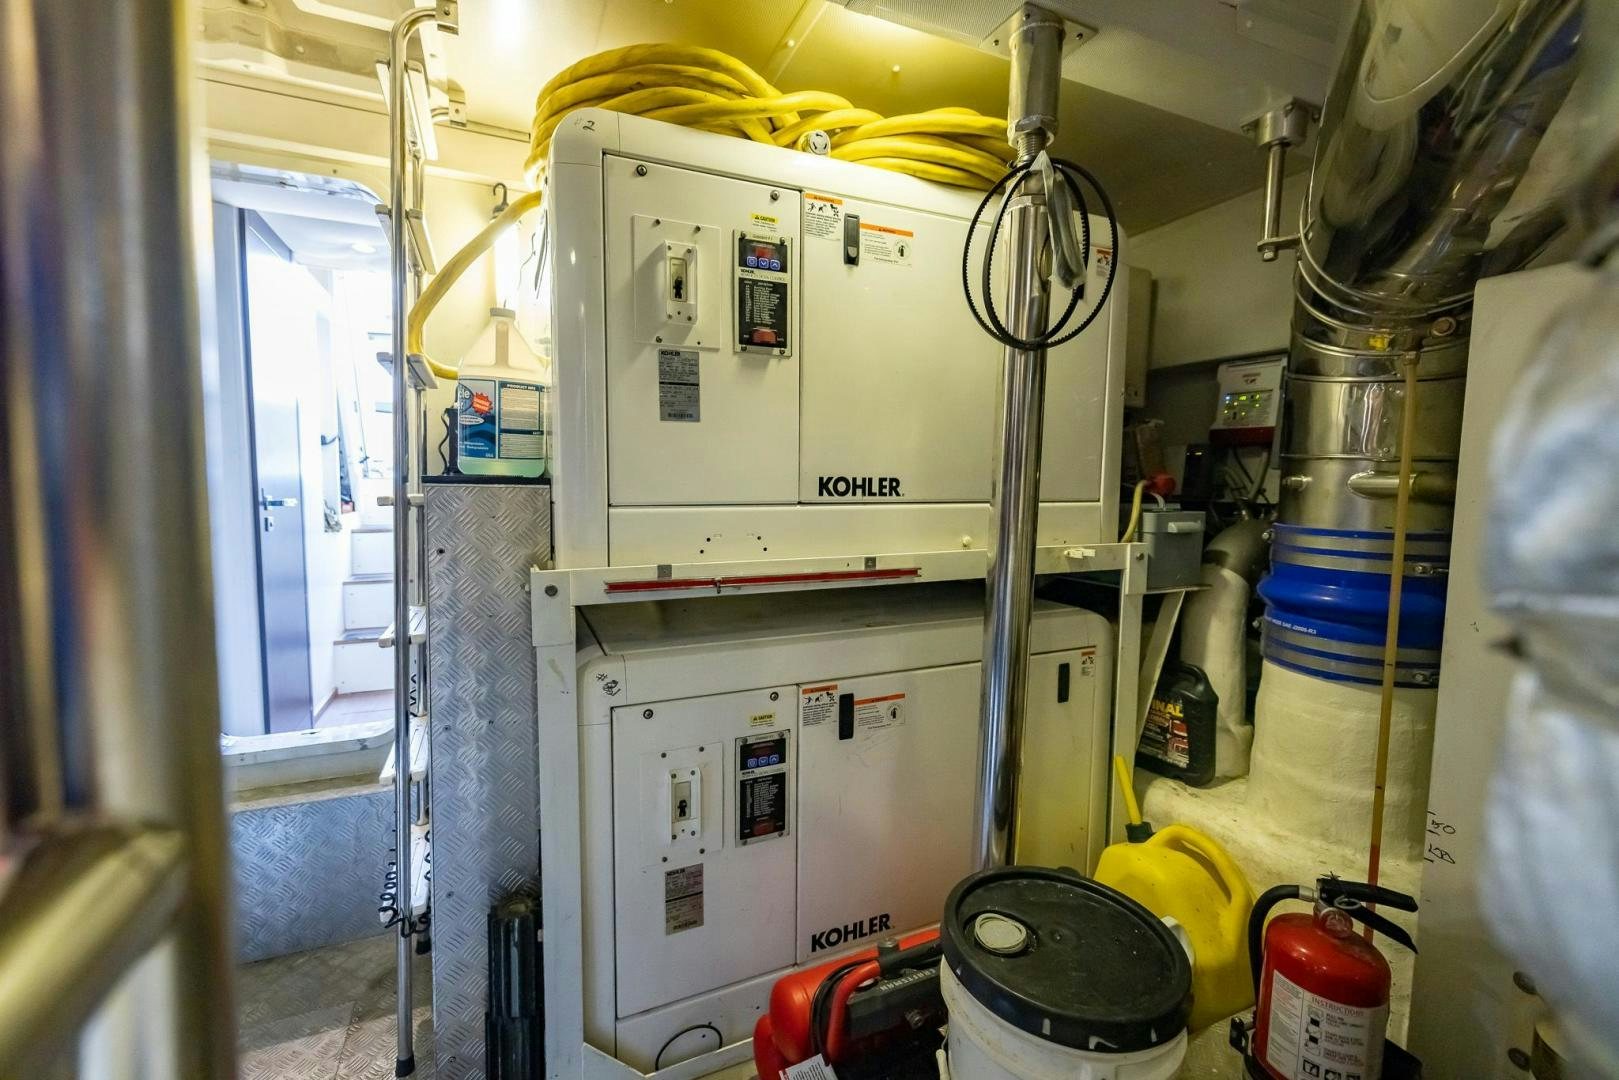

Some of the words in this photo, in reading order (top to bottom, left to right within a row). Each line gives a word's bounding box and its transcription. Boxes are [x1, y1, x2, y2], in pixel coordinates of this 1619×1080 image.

[818, 476, 902, 497] KOHLER
[811, 913, 892, 953] KOHLER
[880, 967, 936, 992] CRAFTSMAN
[1311, 996, 1364, 1018] INSTRUCTIONS
